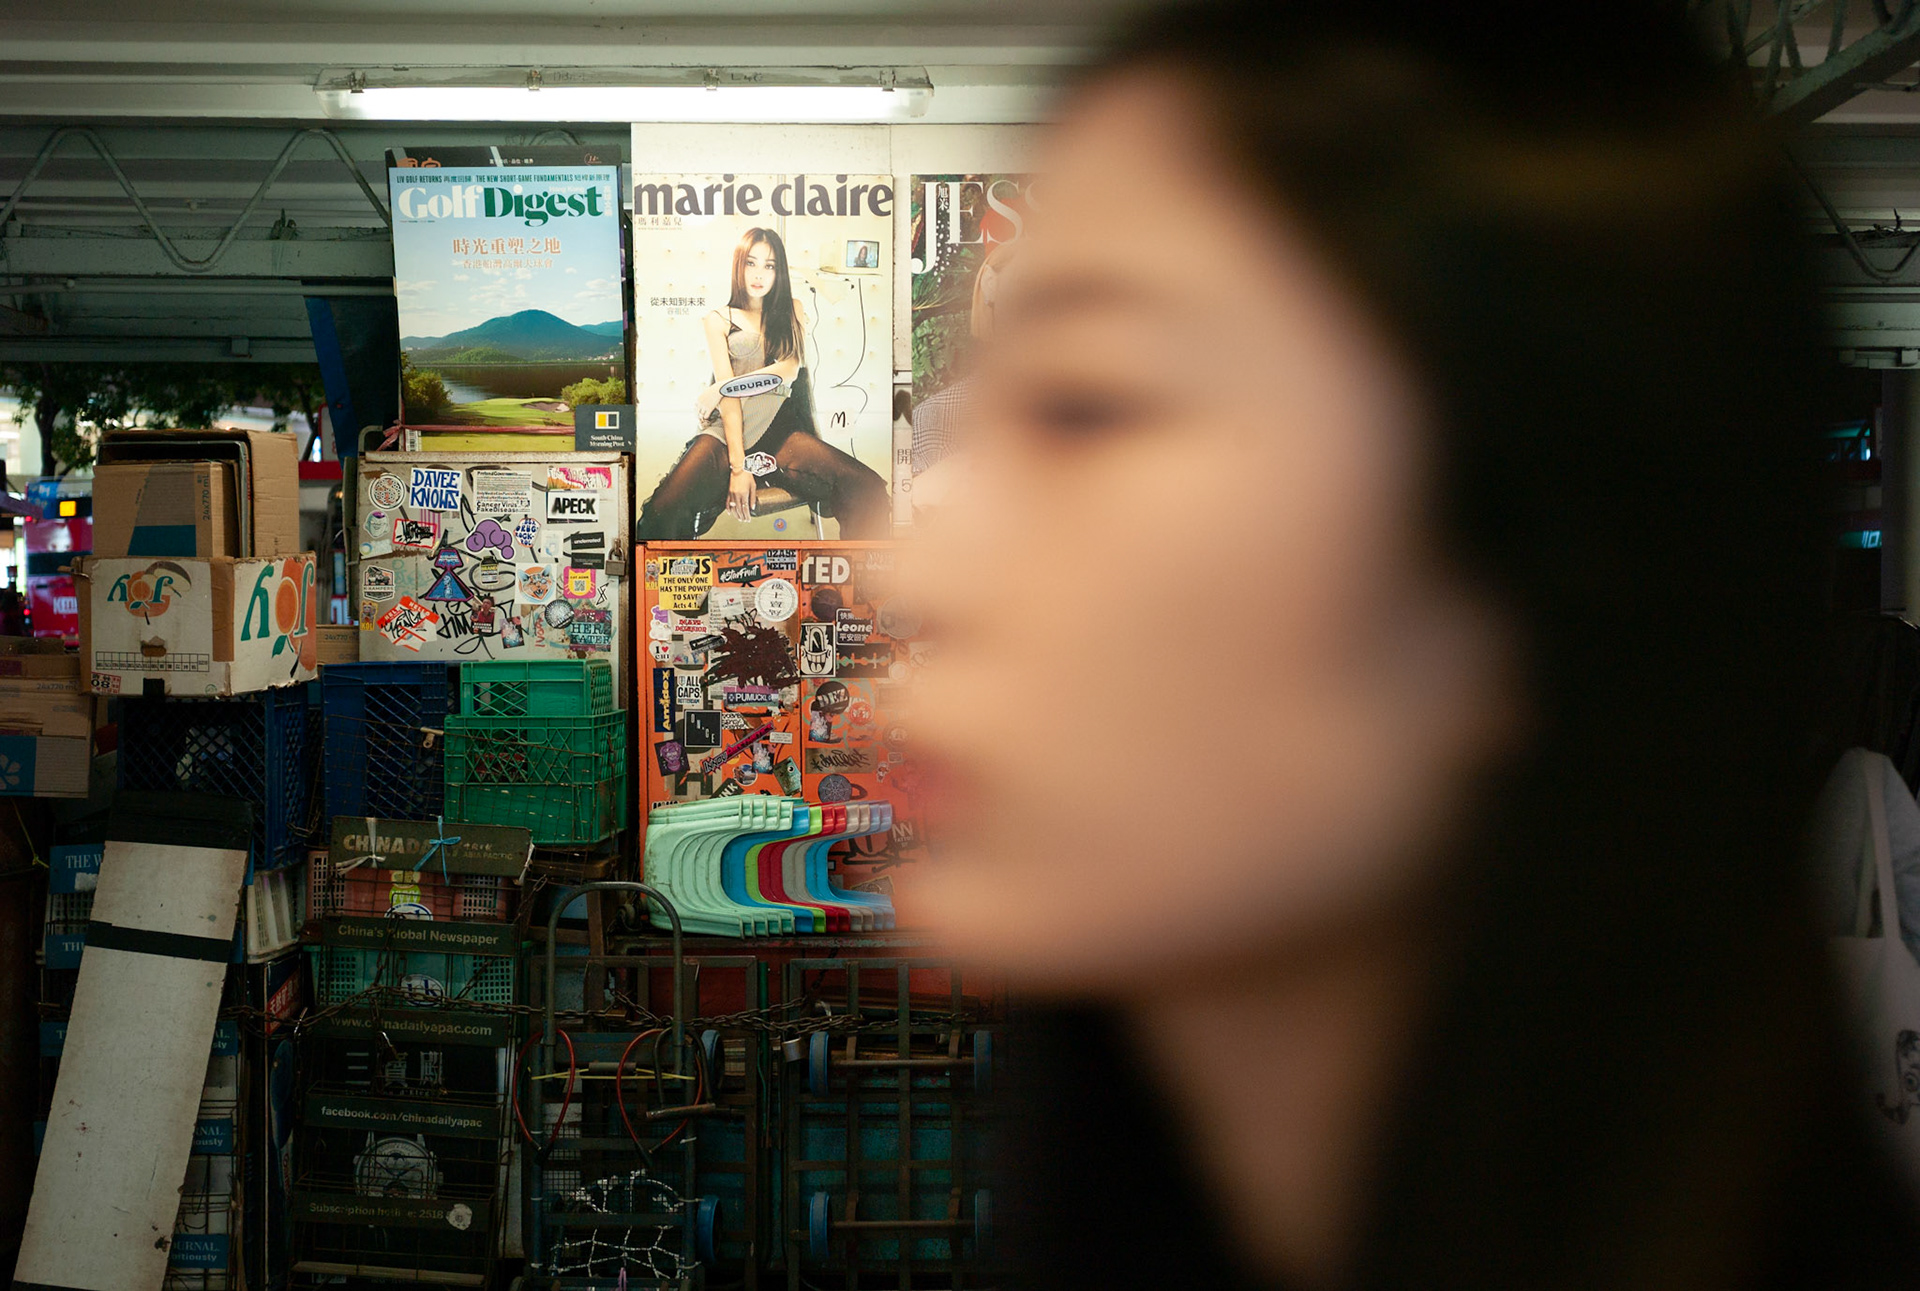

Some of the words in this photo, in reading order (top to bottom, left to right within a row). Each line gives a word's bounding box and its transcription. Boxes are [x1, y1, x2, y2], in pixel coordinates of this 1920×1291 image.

[396, 175, 404, 184] LIV
[405, 175, 418, 184] GOLF
[419, 175, 443, 184] RETURNS
[476, 174, 486, 183] THE
[486, 174, 499, 183] NEW
[500, 174, 533, 183] SHORT-GAME
[533, 174, 574, 182] FUNDAMENTALS
[634, 174, 763, 216] marie
[771, 174, 894, 217] claire
[398, 184, 484, 219] Golf
[484, 184, 604, 228] Digest
[452, 237, 561, 255] 時光重塑之地
[650, 297, 706, 307] 從未知到未來
[726, 378, 779, 393] SEDURRE
[412, 469, 460, 488] DAVEE
[410, 487, 459, 510] KNOWS
[551, 497, 596, 515] APECK
[695, 576, 708, 584] ONE
[836, 621, 873, 632] Leone
[685, 675, 700, 687] ALL
[677, 687, 702, 698] CAPS.
[343, 834, 405, 854] CHNA
[65, 853, 93, 869] THE
[337, 924, 385, 939] China's
[386, 927, 428, 942] lobal
[429, 929, 499, 946] Newspaper
[330, 1015, 492, 1036] www.cinadailyapac.com
[309, 1202, 375, 1217] Subscription
